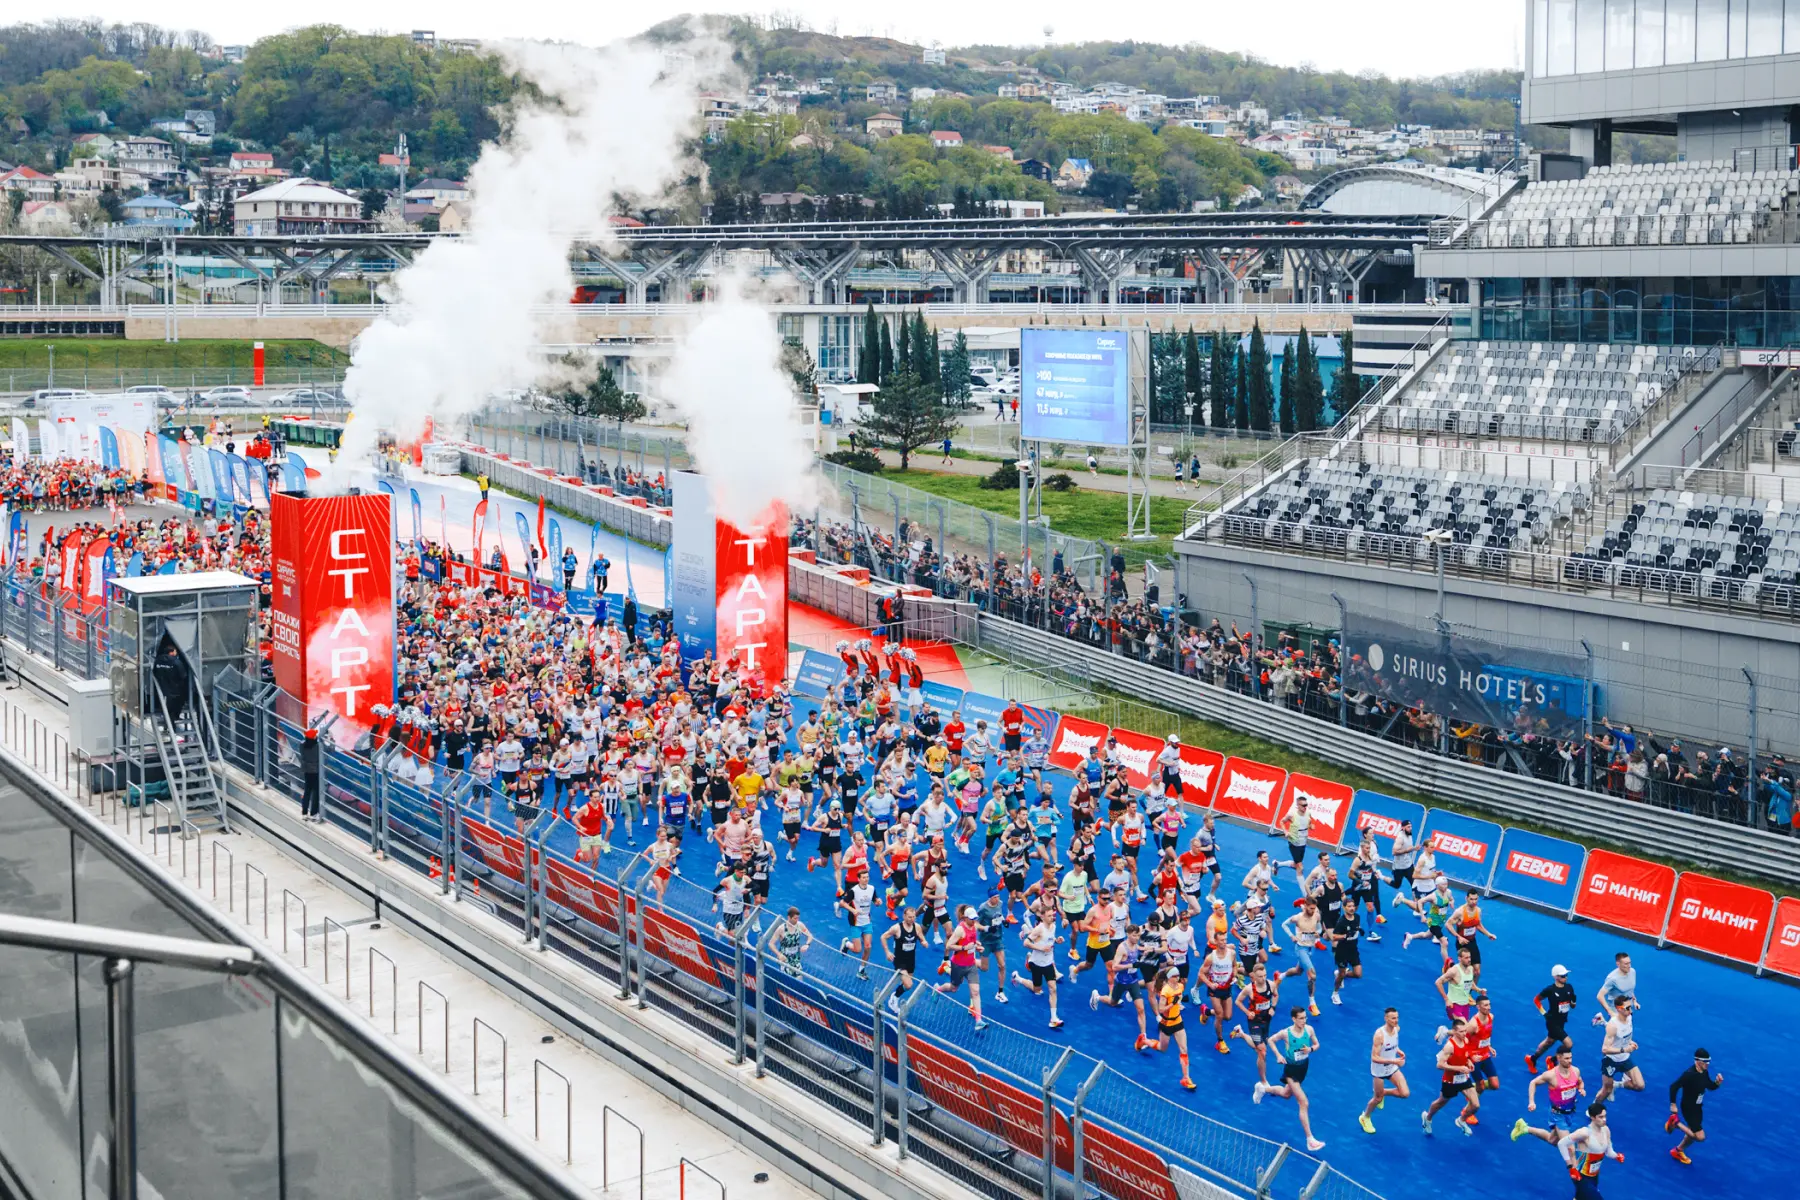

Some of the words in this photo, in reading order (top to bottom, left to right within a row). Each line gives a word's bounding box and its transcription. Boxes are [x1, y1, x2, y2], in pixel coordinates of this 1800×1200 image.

[1758, 353, 1780, 363] 201
[734, 525, 768, 671] ТАРТ
[273, 609, 300, 630] ПОКАЖИ
[327, 528, 371, 717] СТАРТ
[273, 623, 300, 647] СВОЮ
[1392, 653, 1447, 686] SIRIUS
[1459, 669, 1546, 704] HOTELS
[1360, 812, 1402, 837] TEBOI
[1433, 832, 1482, 860] TEBOIL
[1510, 852, 1565, 882] TEBOIL
[1608, 881, 1661, 905] МАГНИТ
[1702, 906, 1758, 931] МАГНИТ
[780, 991, 828, 1027] TEBOIL
[932, 1072, 979, 1102] МАГНИТ
[1016, 1115, 1068, 1148] МАГИТ
[1109, 1162, 1166, 1199] МАГНИТ
